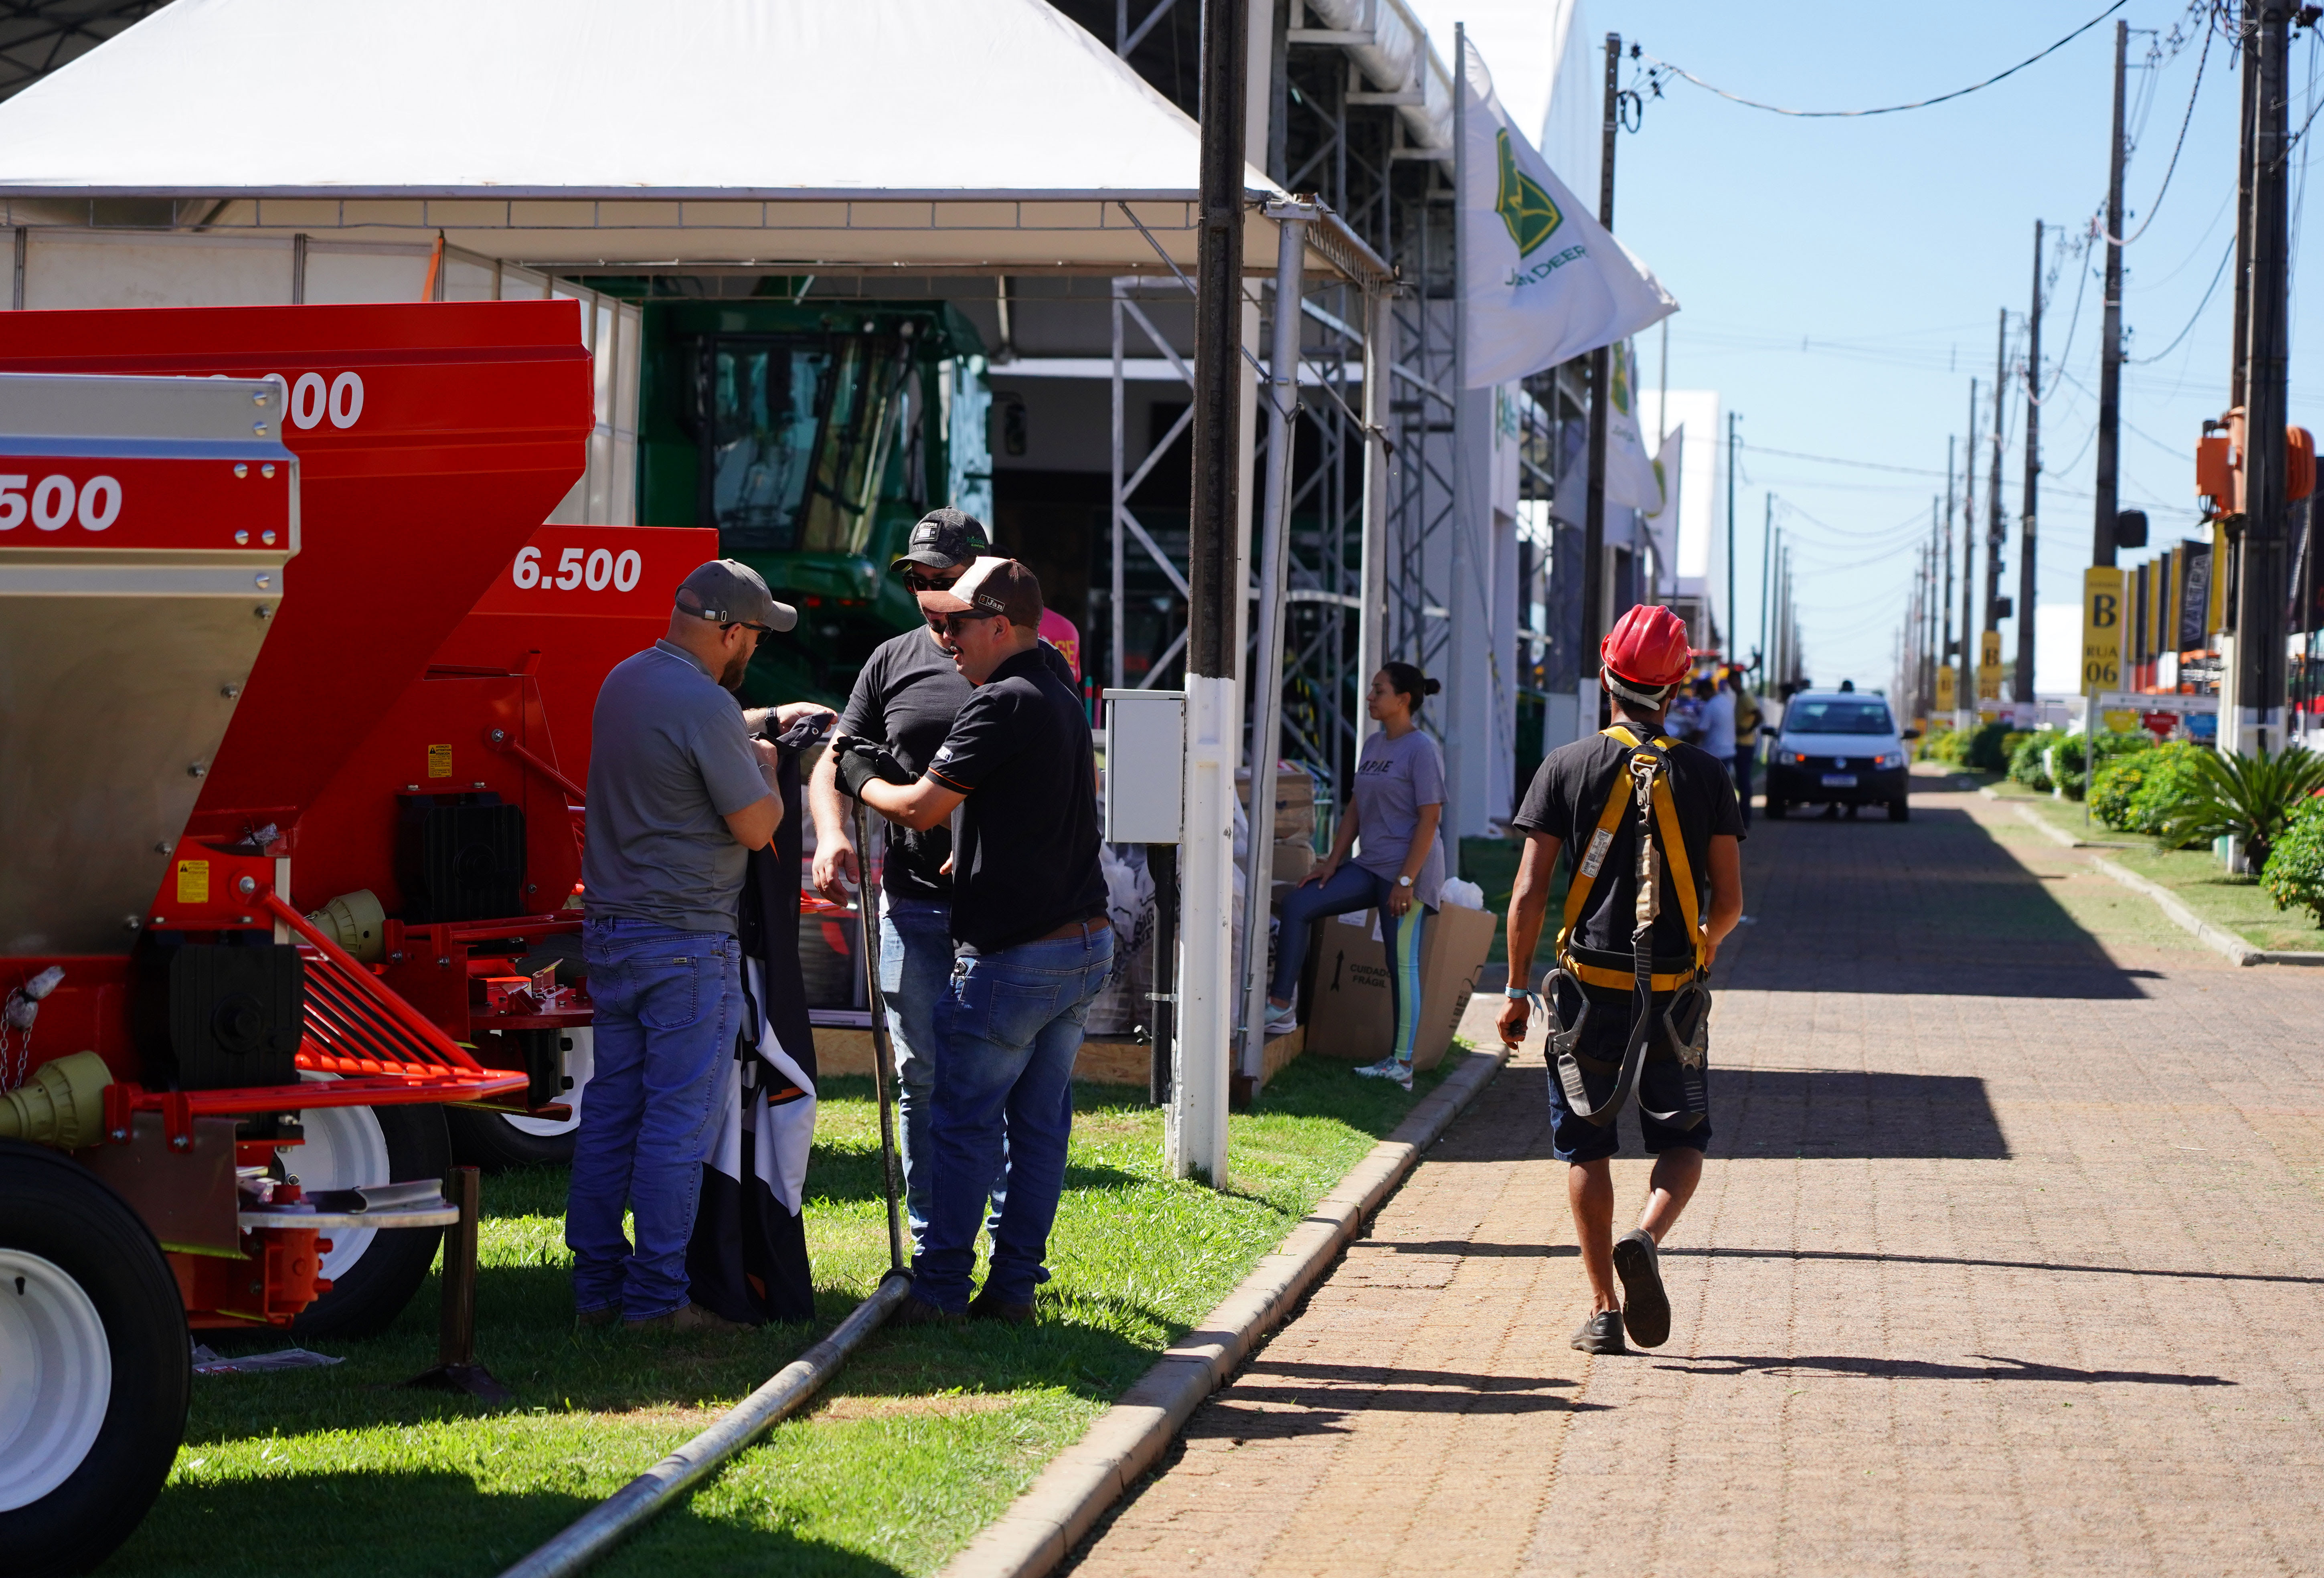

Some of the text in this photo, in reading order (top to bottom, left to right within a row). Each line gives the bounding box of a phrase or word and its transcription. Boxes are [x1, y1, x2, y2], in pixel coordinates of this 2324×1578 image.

[513, 546, 642, 592] 6.500
[988, 599, 1002, 610] Jan
[2093, 593, 2116, 628] B
[2087, 645, 2118, 658] RUA
[2086, 662, 2118, 684] 06
